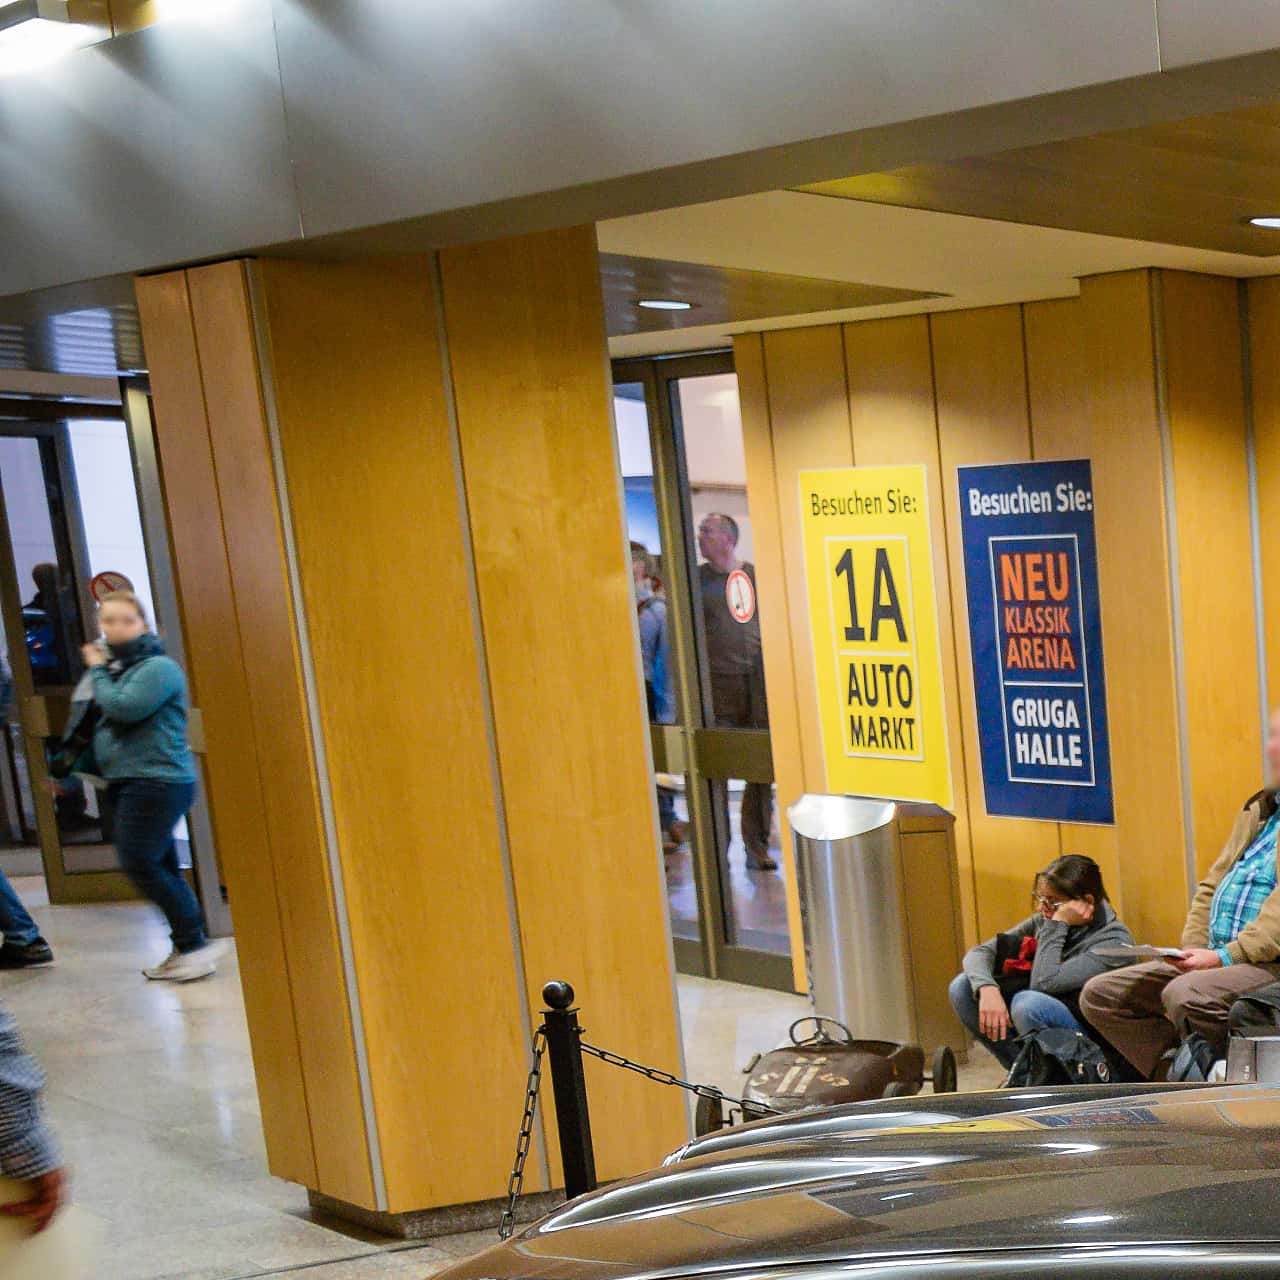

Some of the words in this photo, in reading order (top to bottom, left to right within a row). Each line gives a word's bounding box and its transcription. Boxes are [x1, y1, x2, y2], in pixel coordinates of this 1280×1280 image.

[811, 491, 882, 516] Besuchen
[887, 489, 917, 513] Sie:
[969, 485, 1052, 516] Besuchen
[1056, 482, 1093, 511] Sie:
[1000, 553, 1069, 600] NEU
[835, 548, 908, 642] 1A
[1004, 607, 1071, 634] KLASSIK
[1006, 637, 1076, 670] ARENA
[848, 663, 912, 709] AUTO
[1012, 698, 1080, 729] GRUGA
[850, 715, 915, 750] MARKT
[1015, 733, 1083, 767] HALLE
